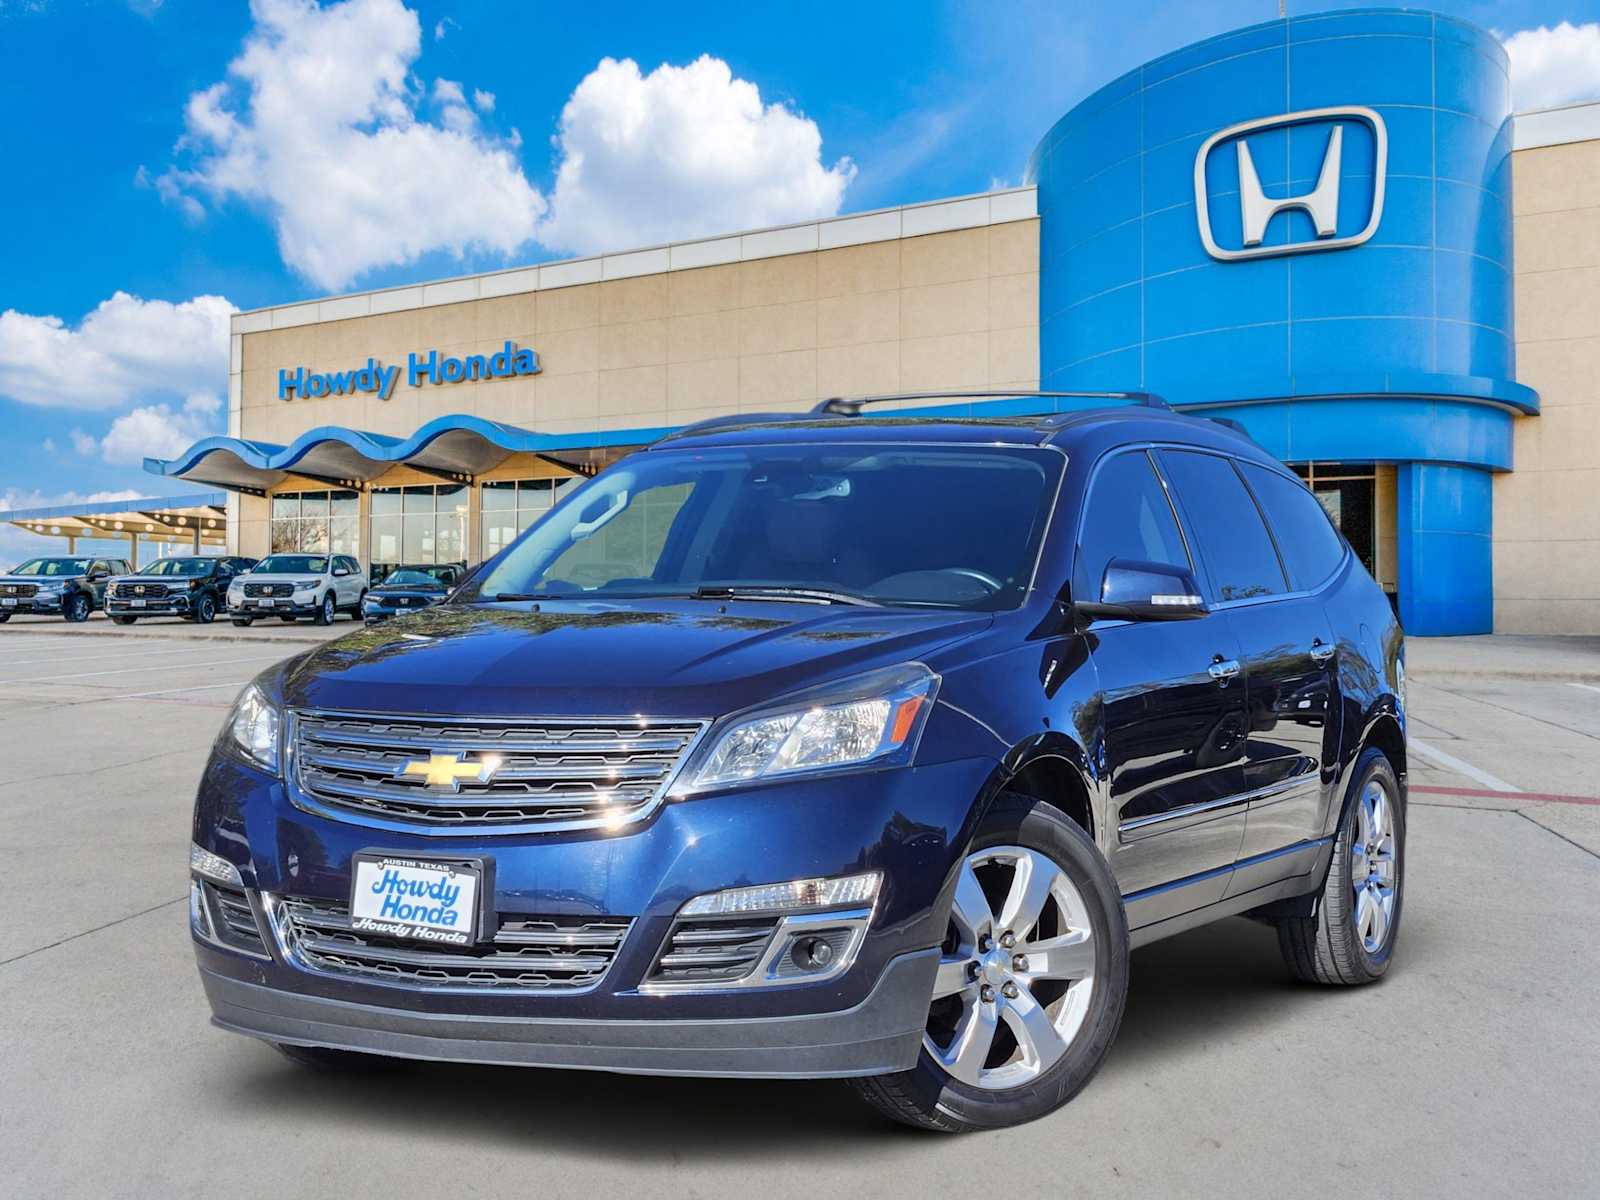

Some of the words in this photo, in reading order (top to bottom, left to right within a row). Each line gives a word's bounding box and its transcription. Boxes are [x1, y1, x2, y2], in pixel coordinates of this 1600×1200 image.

[278, 357, 401, 401] Howdy
[408, 340, 542, 388] Honda
[382, 858, 416, 867] AUSTIN
[419, 860, 450, 871] TEXAS
[371, 869, 460, 907] Howdy
[380, 895, 458, 926] Honda
[352, 918, 411, 937] Howdy
[412, 926, 468, 943] Honda
